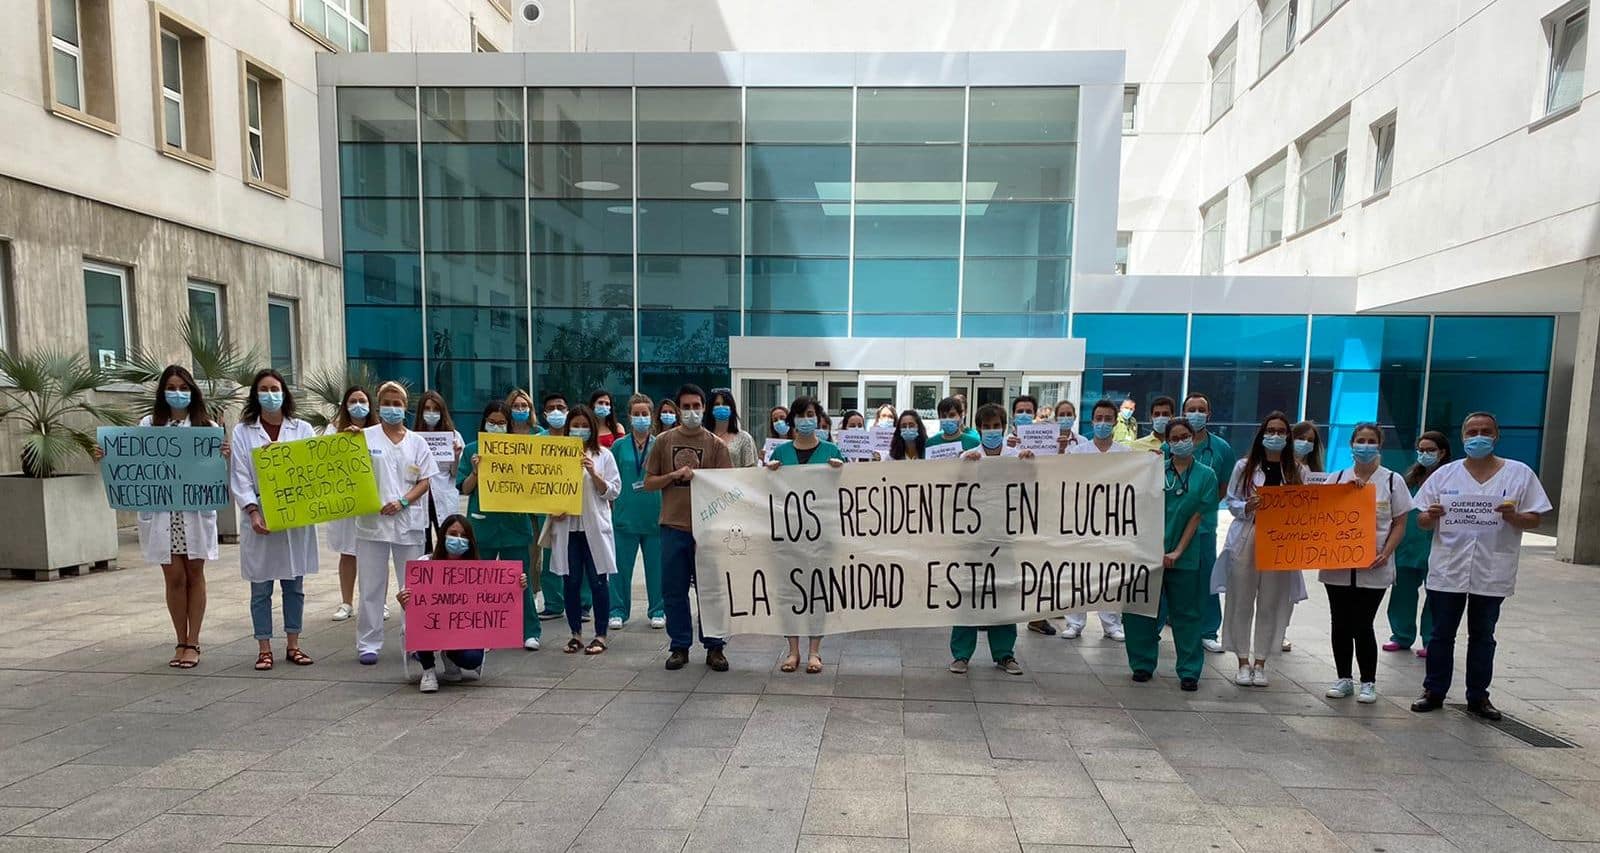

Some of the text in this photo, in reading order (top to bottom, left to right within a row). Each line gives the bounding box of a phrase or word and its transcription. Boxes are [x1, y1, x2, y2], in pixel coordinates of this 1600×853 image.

[104, 432, 182, 458] MÉDICOS
[260, 436, 361, 469] SER POCOS
[483, 440, 533, 456] NECESITAN
[285, 456, 371, 484] PRECARIOS
[491, 461, 563, 476] PARA MEJORAR
[108, 480, 230, 507] NECESITAN FORMACIÓN
[274, 477, 357, 505] PERJUDICA
[486, 478, 579, 495] VUESTRA ATENCIÓN
[277, 496, 356, 525] TU SALUD
[768, 476, 1138, 543] LOS RESIDENTES EN LUCHA
[1284, 510, 1360, 526] LUCHANDO
[410, 566, 516, 586] SIN RESIDENTES
[725, 546, 1149, 617] LA SANIDAD ESTÁ PACHUCHA
[414, 594, 427, 606] LA
[431, 592, 469, 606] SANIDAD
[424, 609, 510, 630] SE RESIENTE
